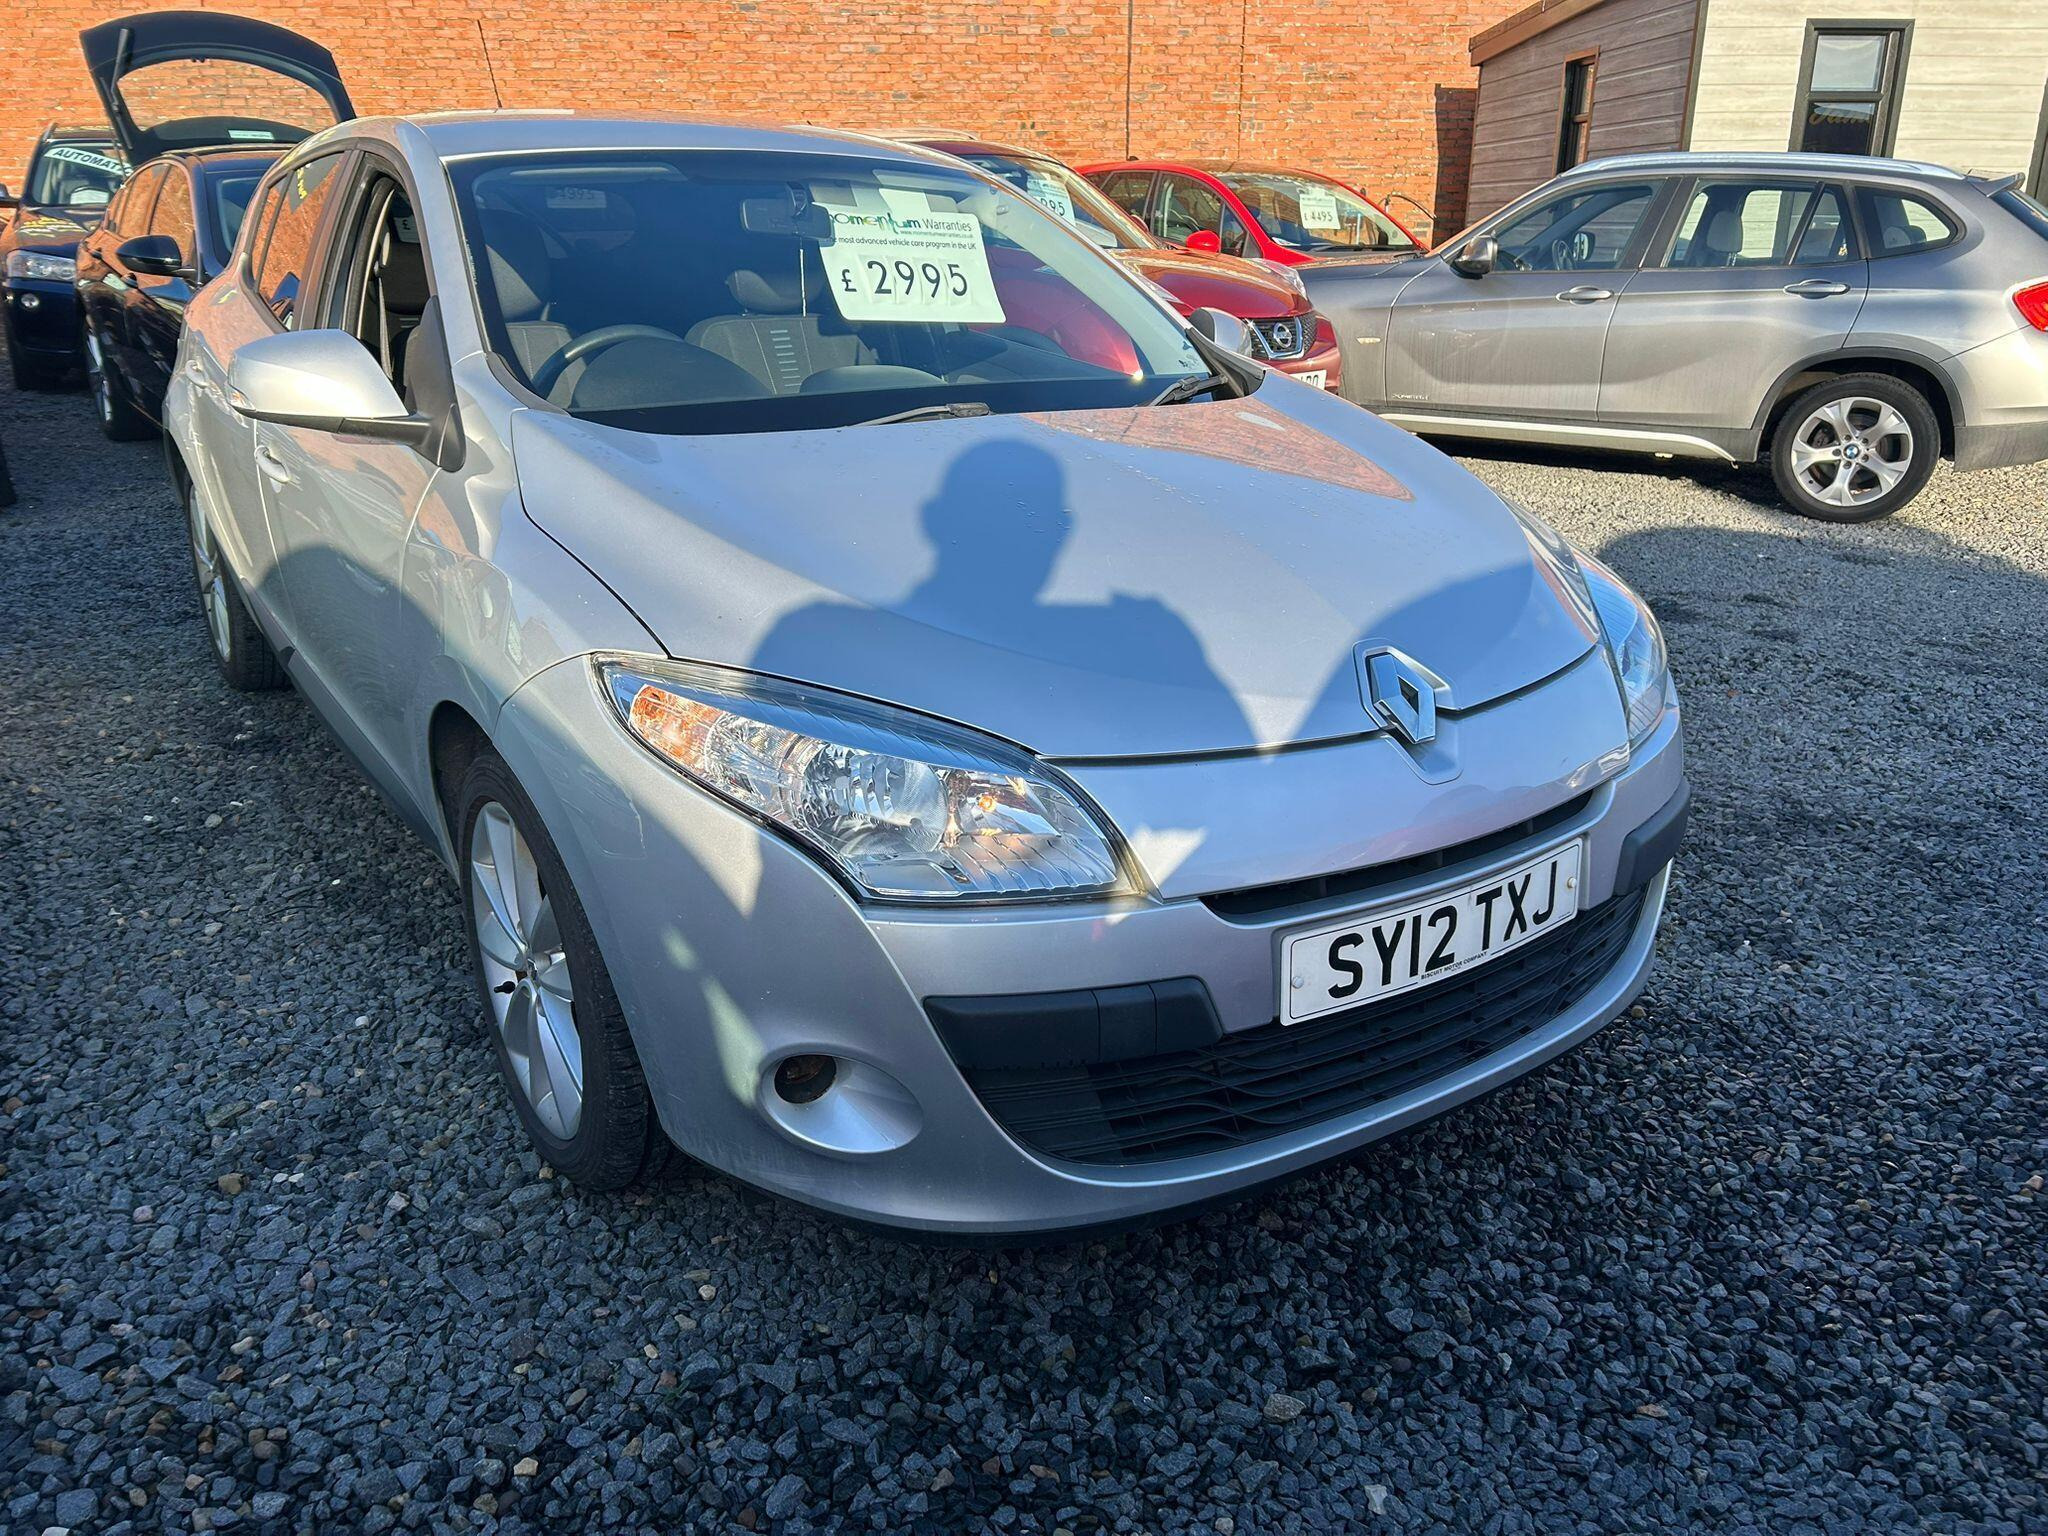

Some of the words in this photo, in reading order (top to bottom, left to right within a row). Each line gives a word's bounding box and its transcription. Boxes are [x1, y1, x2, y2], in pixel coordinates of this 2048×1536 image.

[921, 218, 971, 232] Warranties
[855, 237, 888, 245] advanced
[889, 238, 910, 246] vehicle
[925, 241, 951, 249] program
[841, 268, 857, 292] £
[867, 260, 968, 298] 2995
[1327, 905, 1458, 999] SY12
[1476, 861, 1558, 951] TXJ
[1421, 967, 1443, 980] BISCUIT
[1444, 960, 1463, 972] MOTOR
[1463, 951, 1488, 965] COMPANY
